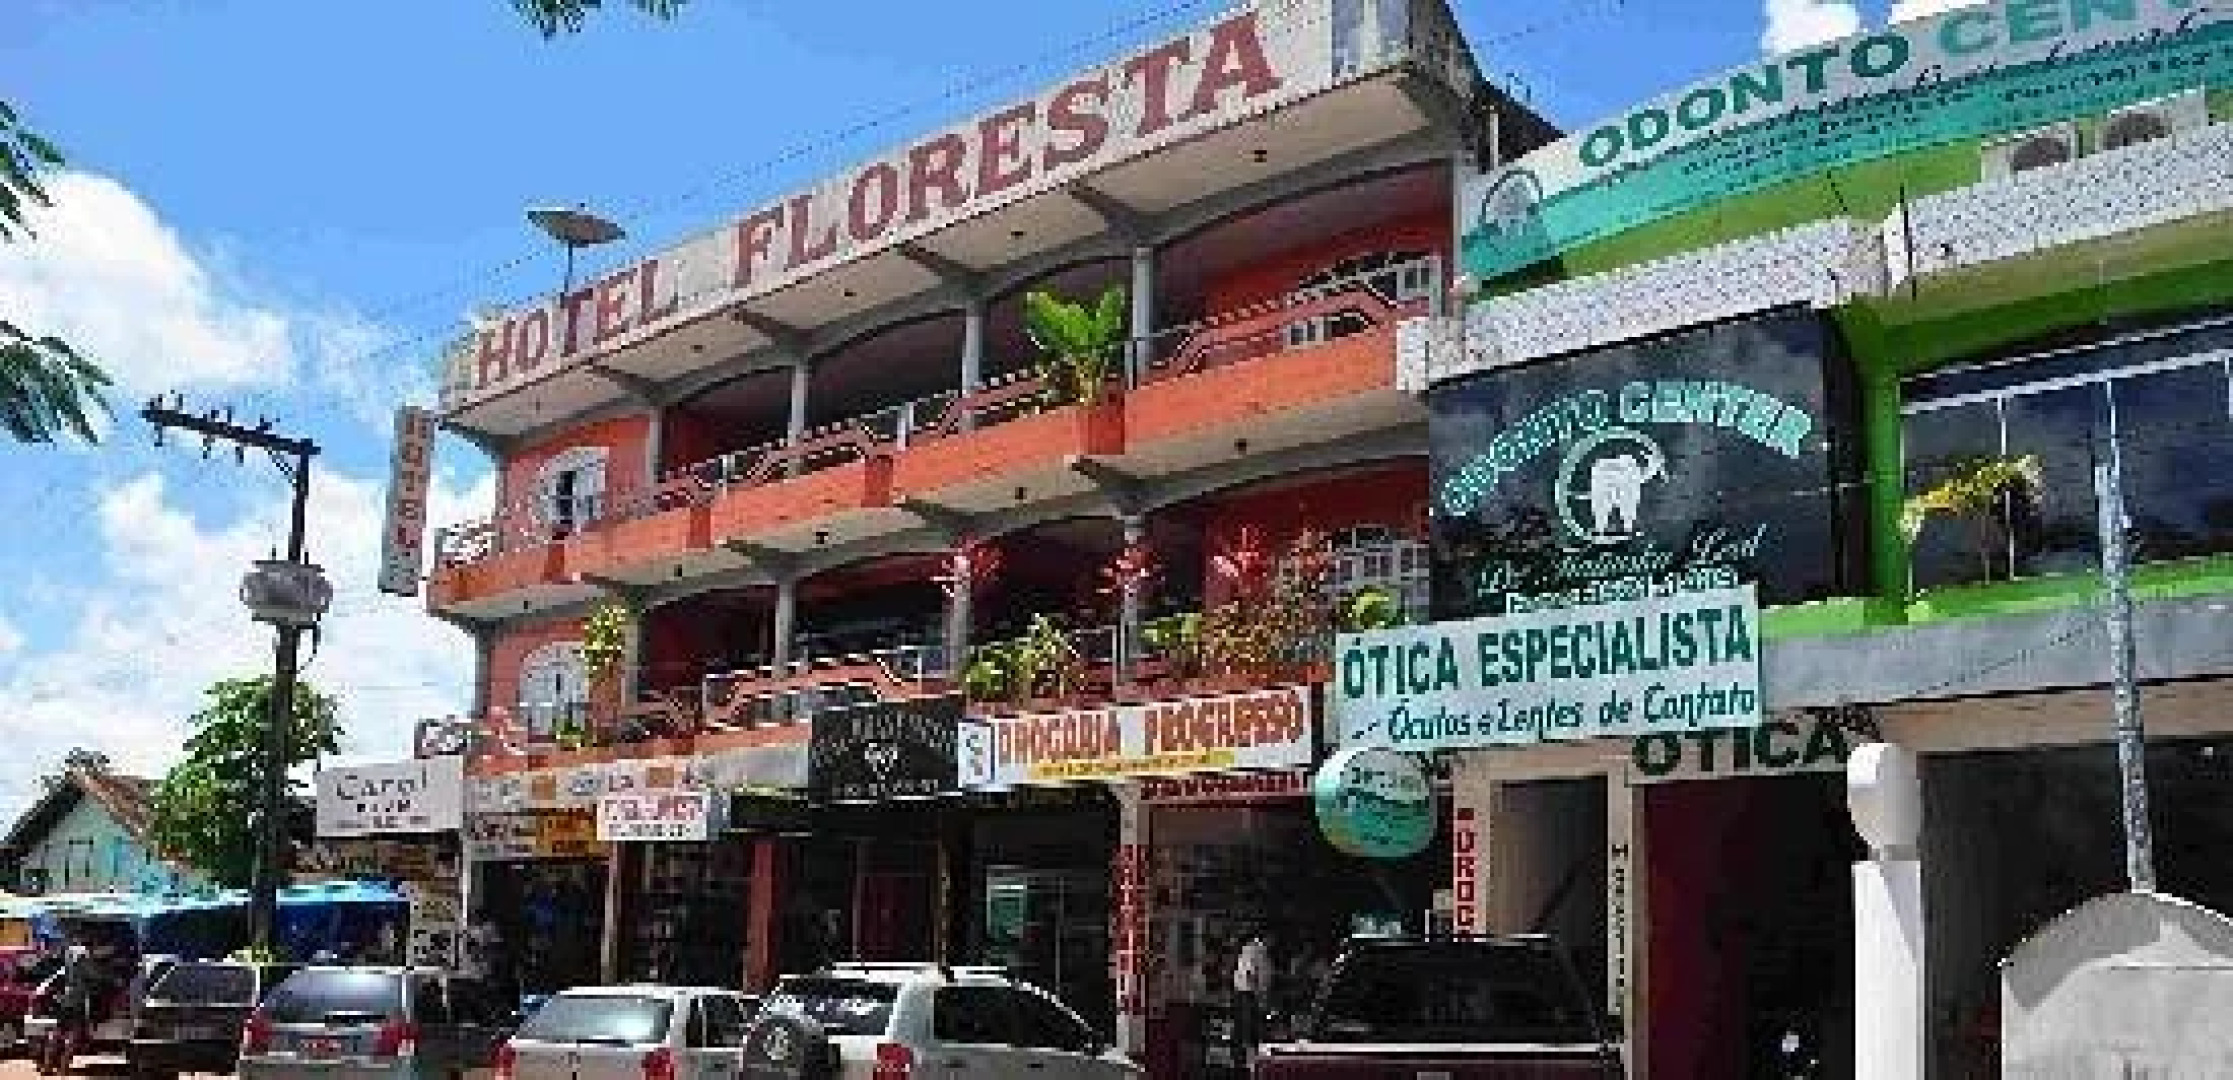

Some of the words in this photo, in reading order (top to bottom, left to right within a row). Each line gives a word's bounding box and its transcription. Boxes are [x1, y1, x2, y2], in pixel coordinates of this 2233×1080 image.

[1579, 35, 1909, 167] ODONTO
[475, 259, 678, 391] HOTEL
[731, 11, 1281, 288] FLORESTA
[1620, 380, 1813, 460] CENTER
[1343, 637, 1459, 699] ÓTICA
[1476, 605, 1752, 688] ESPECIALISTA
[1144, 691, 1303, 757] PROGRESSO
[1497, 697, 1584, 739] Lentes
[1600, 690, 1633, 725] de
[1643, 681, 1756, 727] Contato
